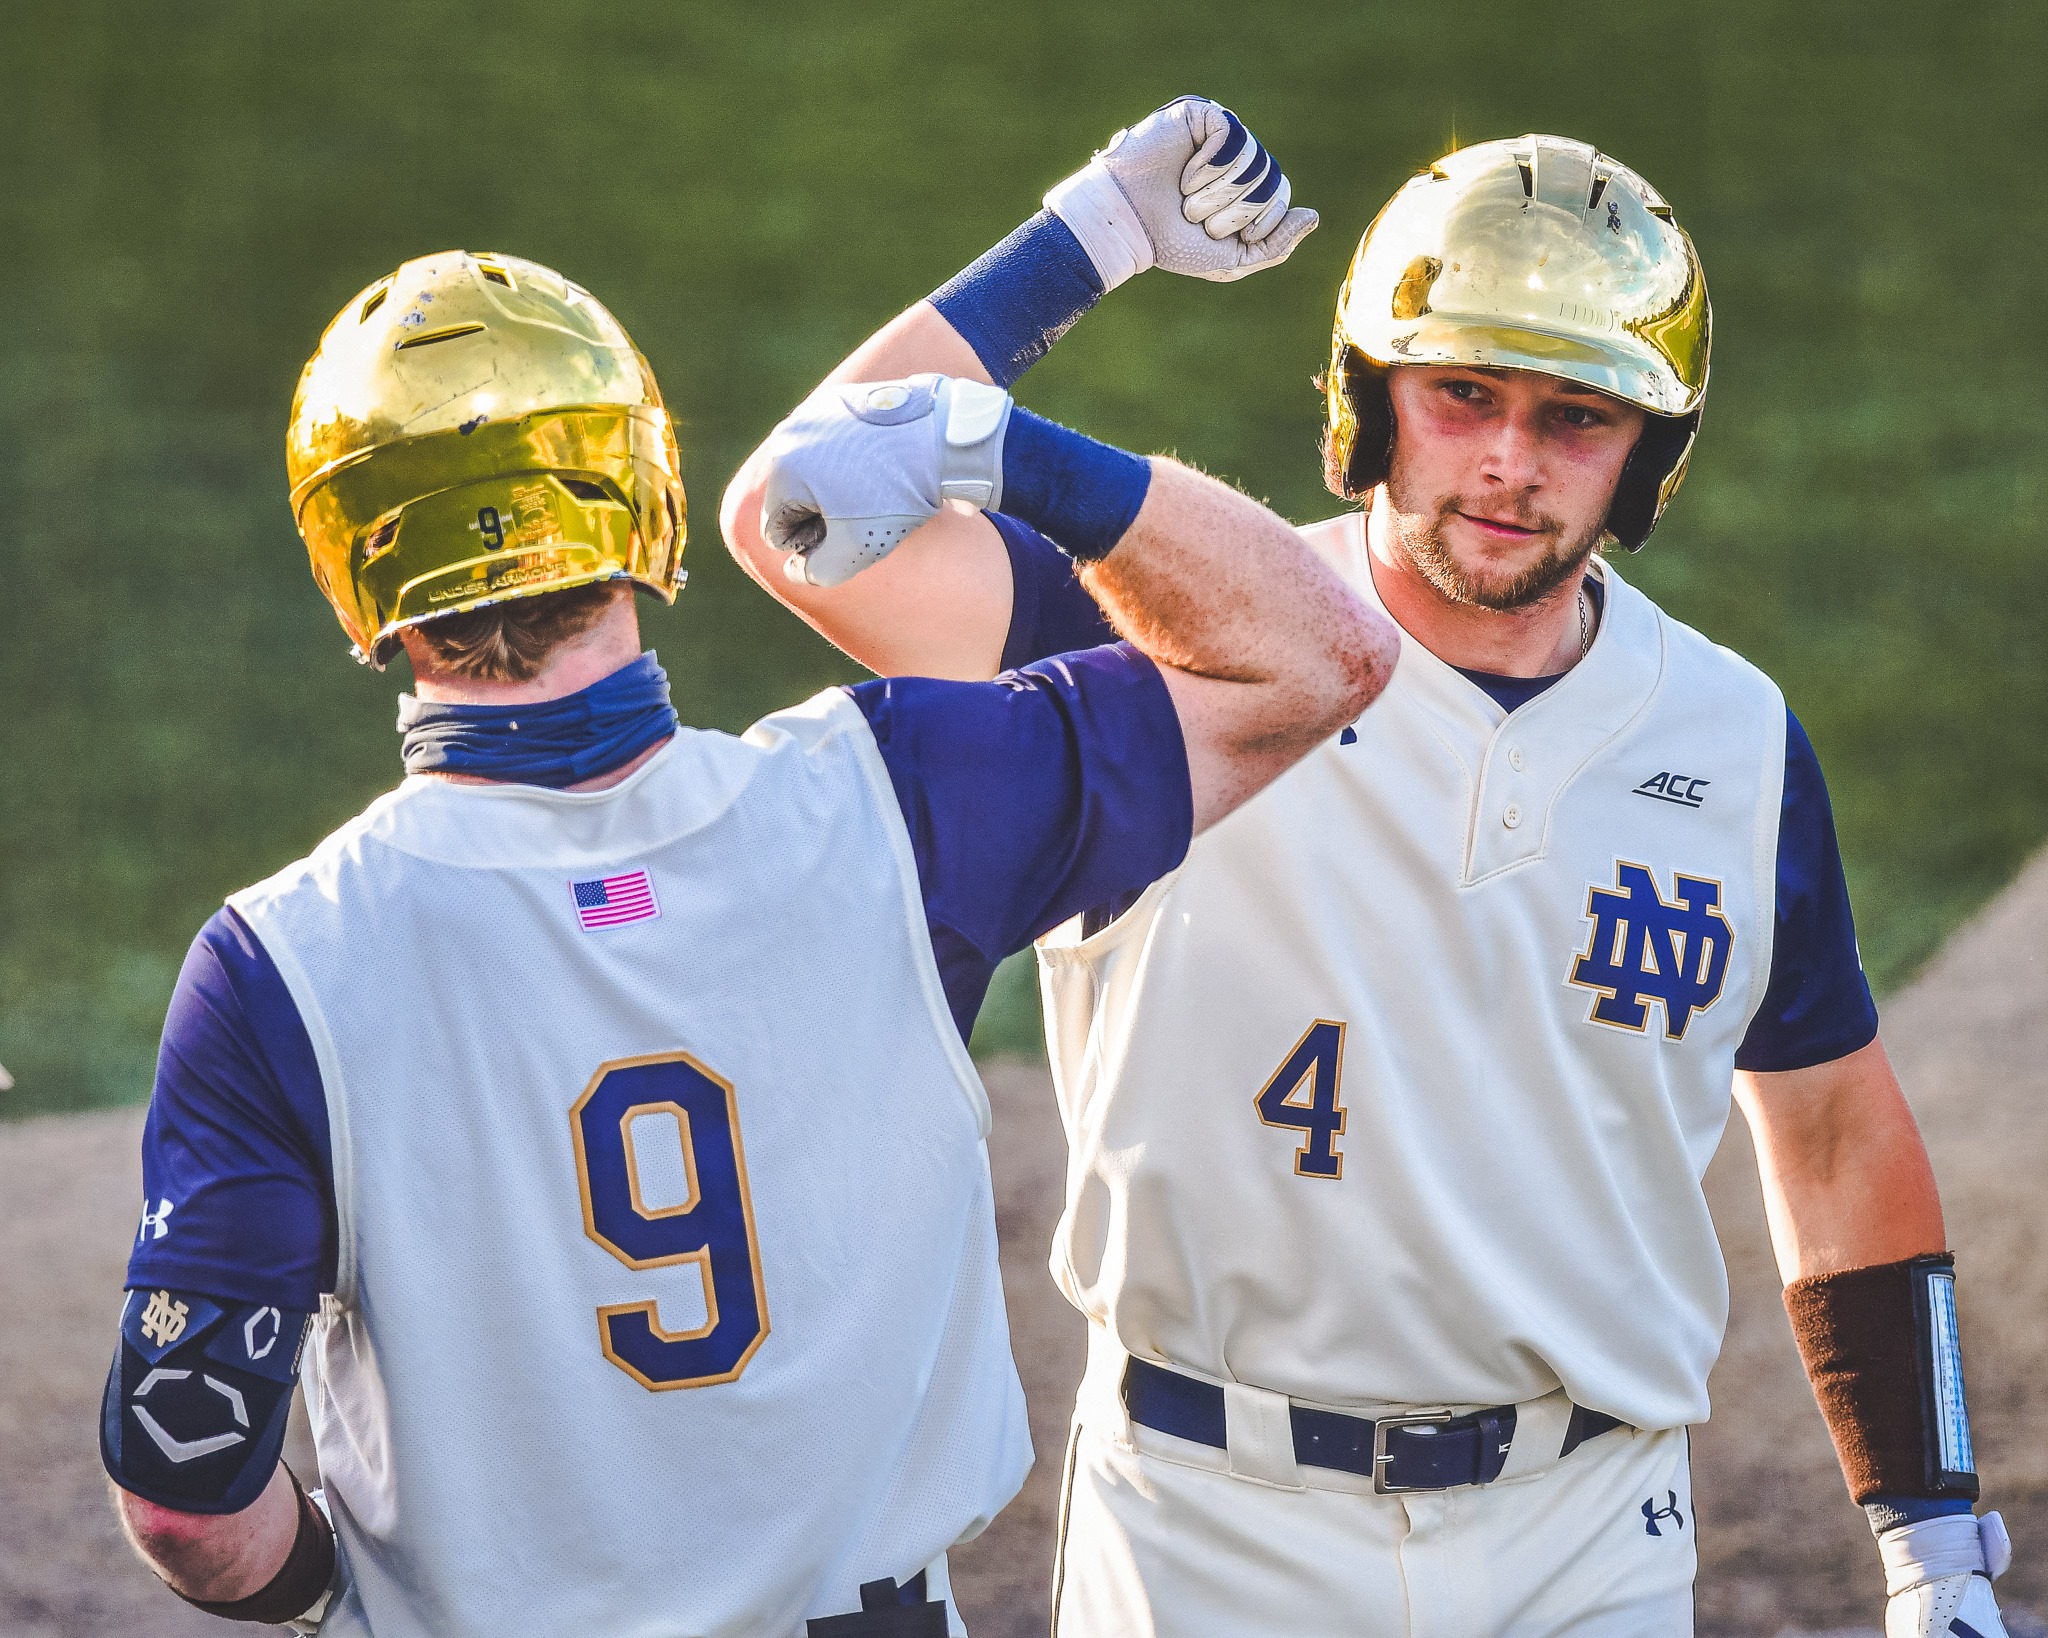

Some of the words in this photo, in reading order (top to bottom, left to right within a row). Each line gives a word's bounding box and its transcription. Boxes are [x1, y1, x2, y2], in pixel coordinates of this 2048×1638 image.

[477, 506, 504, 551] 9
[428, 578, 489, 603] UNDER
[1639, 771, 1711, 803] ACC
[1253, 1018, 1347, 1181] 4
[569, 1050, 772, 1393] 9
